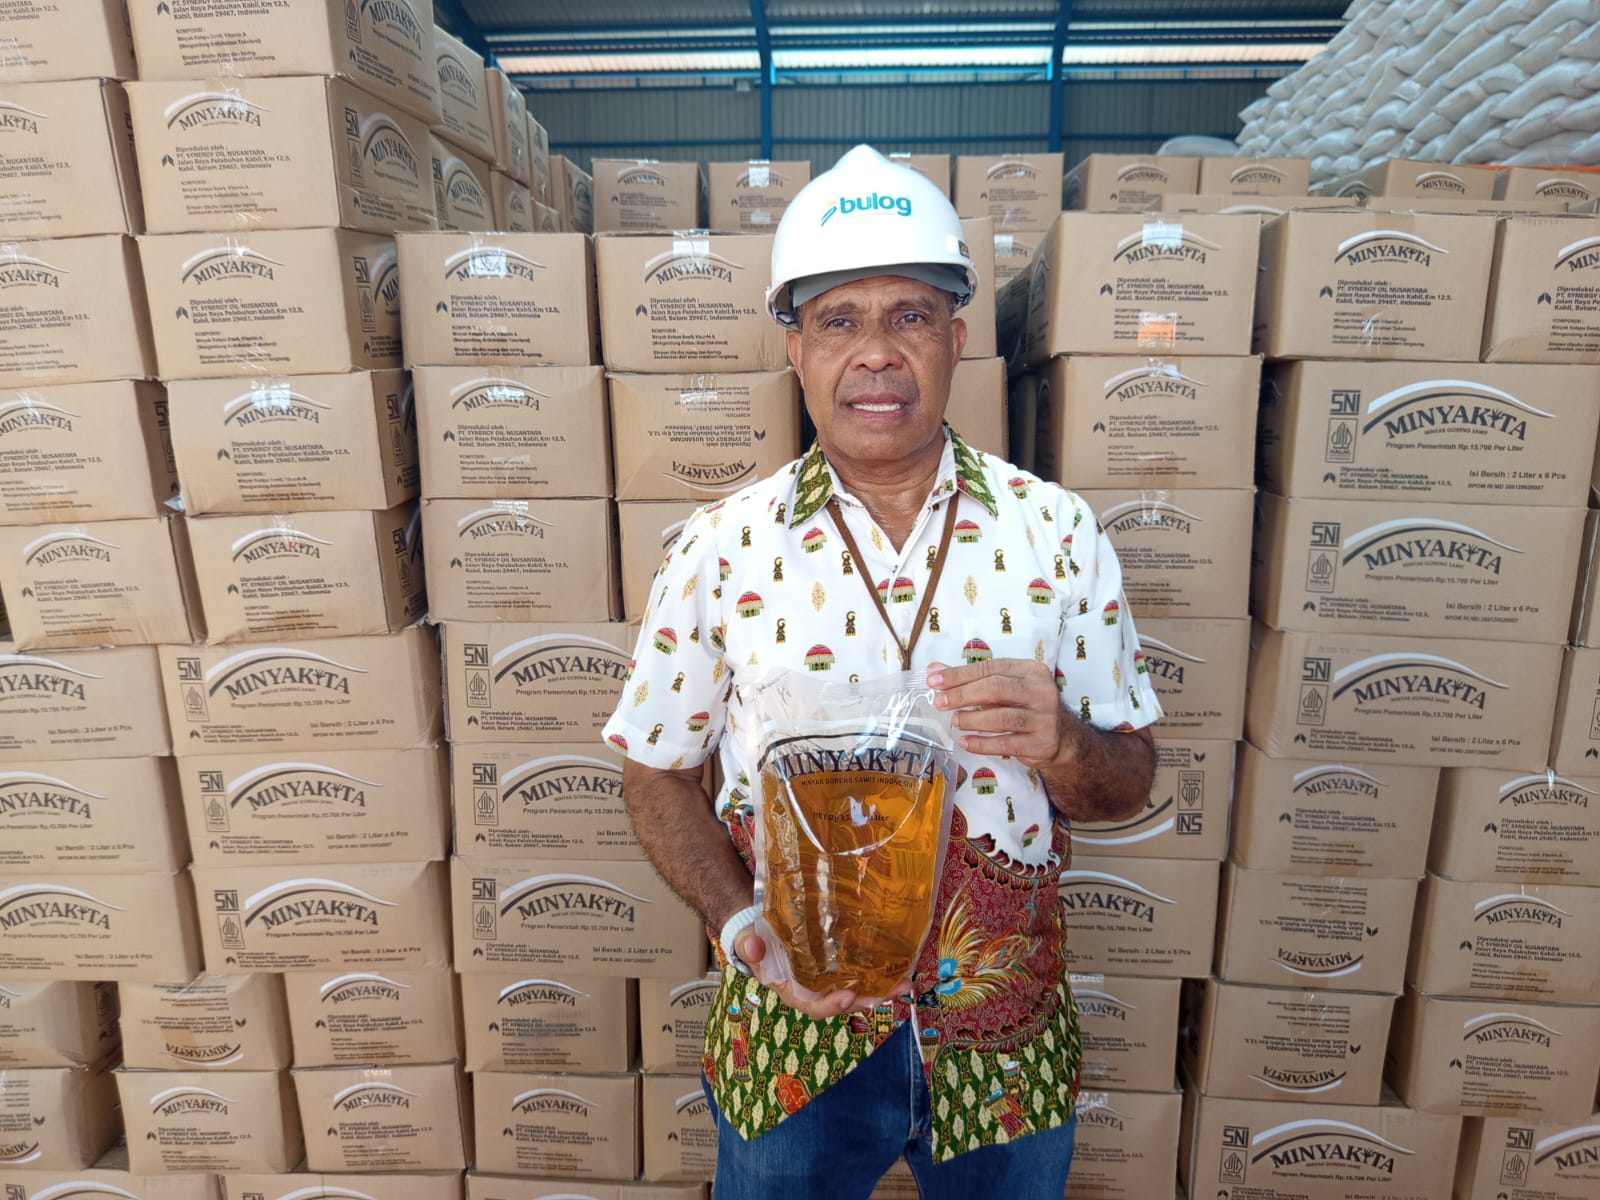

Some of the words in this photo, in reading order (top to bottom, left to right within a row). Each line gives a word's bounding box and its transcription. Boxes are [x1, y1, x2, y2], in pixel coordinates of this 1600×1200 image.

[179, 105, 262, 131] MINYAKITA
[839, 192, 912, 216] bulog
[1125, 244, 1206, 265] MINYAKITA
[1347, 245, 1431, 267] MINYAKITA
[192, 262, 274, 285] MINYAKITA
[656, 263, 732, 284] MINYAKITA
[1116, 381, 1196, 402] MINYAKITA
[237, 405, 320, 428] MINYAKITA
[1384, 404, 1527, 441] MINYAKITA
[1469, 470, 1479, 478] Isi
[1480, 470, 1506, 478] Bersih
[471, 520, 544, 540] MINYAKITA
[34, 544, 111, 567] MINYAKITA
[243, 541, 321, 564] MINYAKITA
[1363, 539, 1502, 575] MINYAKITA
[1446, 602, 1456, 610] Isi
[1458, 603, 1481, 611] Bersih
[1494, 604, 1511, 612] Liter
[463, 643, 489, 666] SNI
[0, 673, 86, 701] YAKITA
[224, 667, 350, 700] MINYAKITA
[1352, 675, 1486, 710] MINYAKITA
[472, 763, 497, 785] SNI
[248, 780, 366, 811] MINYAKITA
[519, 775, 625, 806] MINYAKIT
[1304, 778, 1379, 799] MINYAKITA
[1512, 790, 1588, 808] MINYAKITA
[0, 792, 91, 819] NYAKITA
[472, 878, 496, 900] SNI
[261, 900, 379, 930] MINYAKITA
[517, 892, 634, 923] MINYAKITA
[1059, 892, 1155, 923] NYAKITA
[1486, 907, 1563, 929] MINYAKITA
[332, 987, 400, 1005] MINYAKITA
[507, 989, 576, 1007] MINYAKITA
[1475, 1028, 1551, 1048] MINYAKITA
[163, 1098, 229, 1117] MINYAKITA
[342, 1093, 410, 1111] MINYAKITA
[522, 1099, 588, 1118] MINYAKITA
[1270, 1143, 1394, 1173] MINYAKITA
